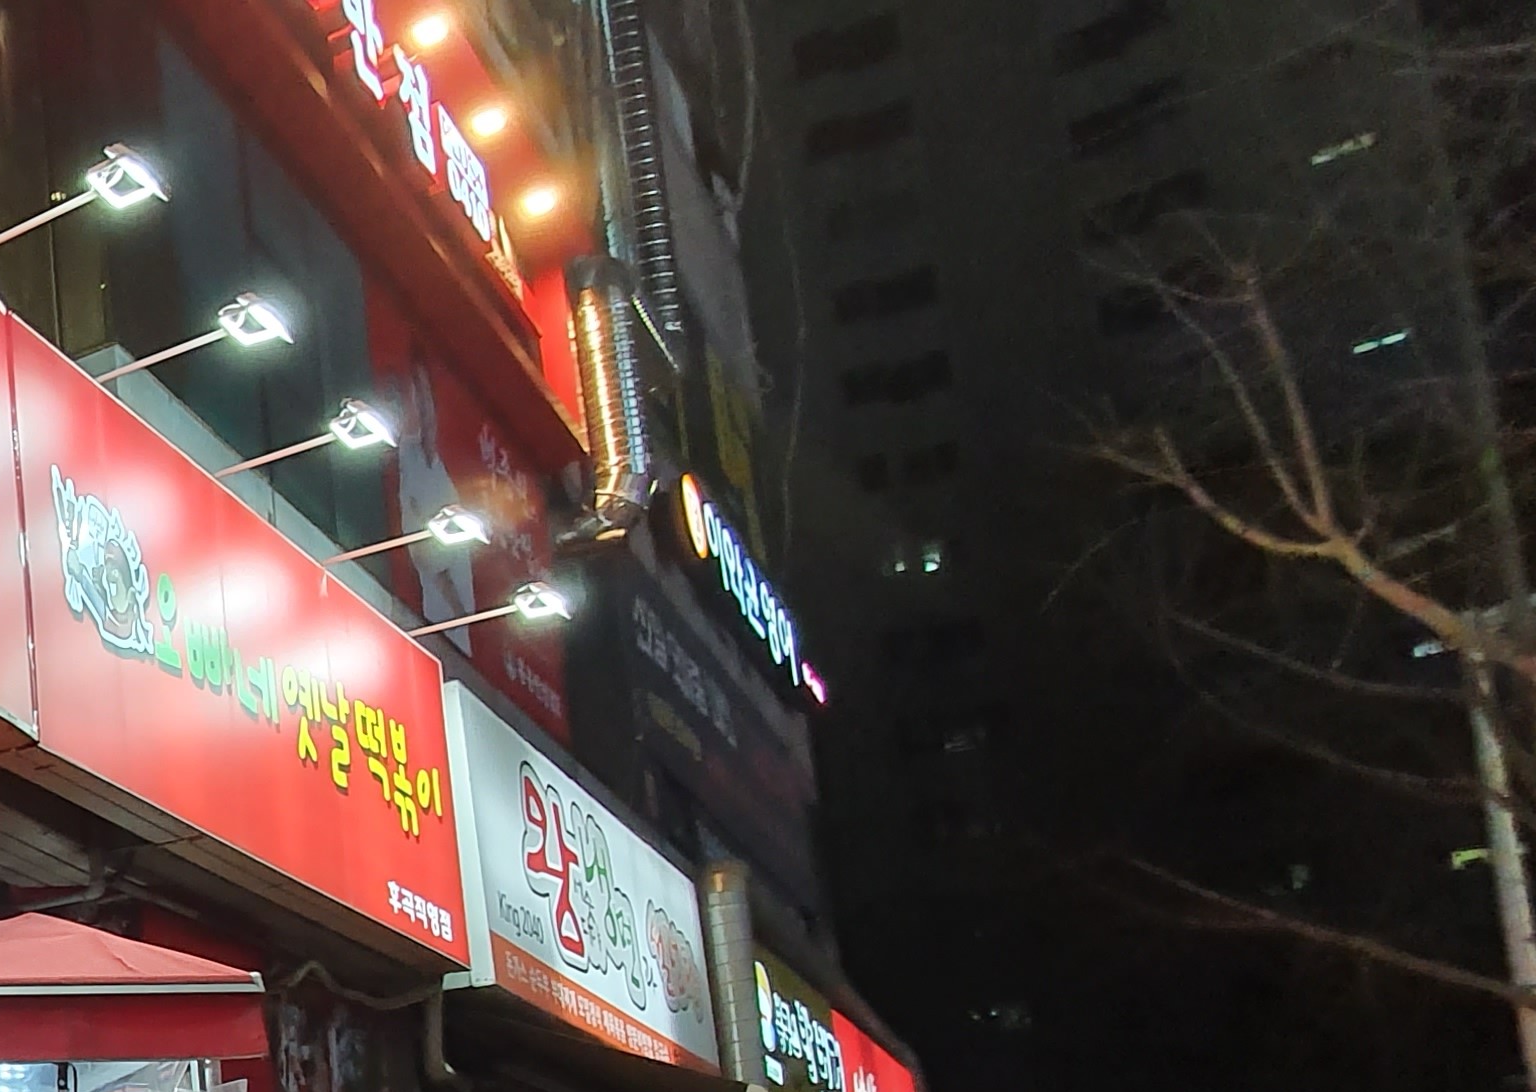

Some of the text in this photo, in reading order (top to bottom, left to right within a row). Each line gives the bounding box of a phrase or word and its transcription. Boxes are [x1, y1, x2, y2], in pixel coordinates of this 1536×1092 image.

[154, 572, 280, 724] 오빠네
[281, 664, 351, 789] 옛날
[353, 698, 443, 837] 떡볶이
[387, 881, 454, 943] 후곡직영점
